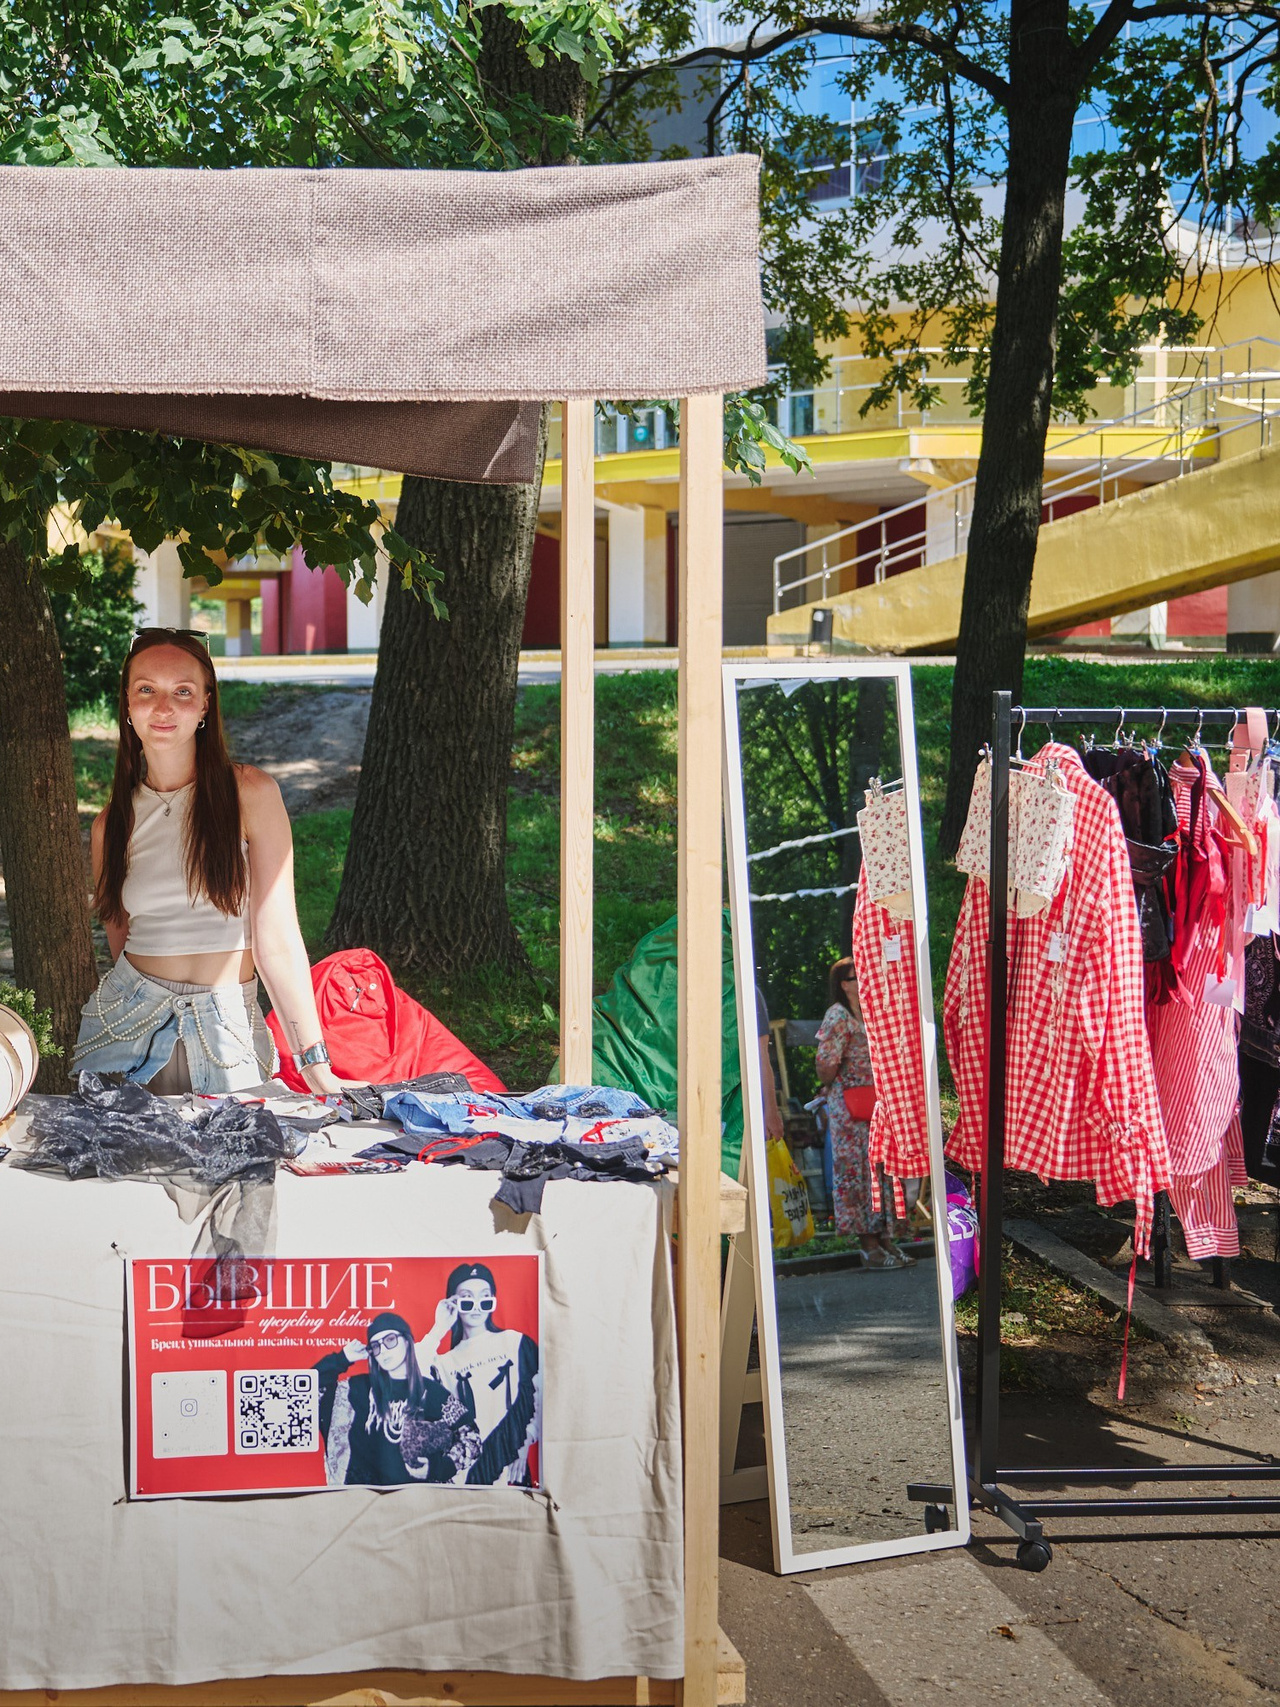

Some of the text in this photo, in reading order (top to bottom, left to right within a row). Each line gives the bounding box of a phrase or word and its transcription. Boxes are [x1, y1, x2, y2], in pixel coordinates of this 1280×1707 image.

[147, 1263, 395, 1312] БЫВШИЕ
[258, 1309, 373, 1334] upcycling clothes
[151, 1336, 352, 1352] Бренд уникальной апсайкл одежды
